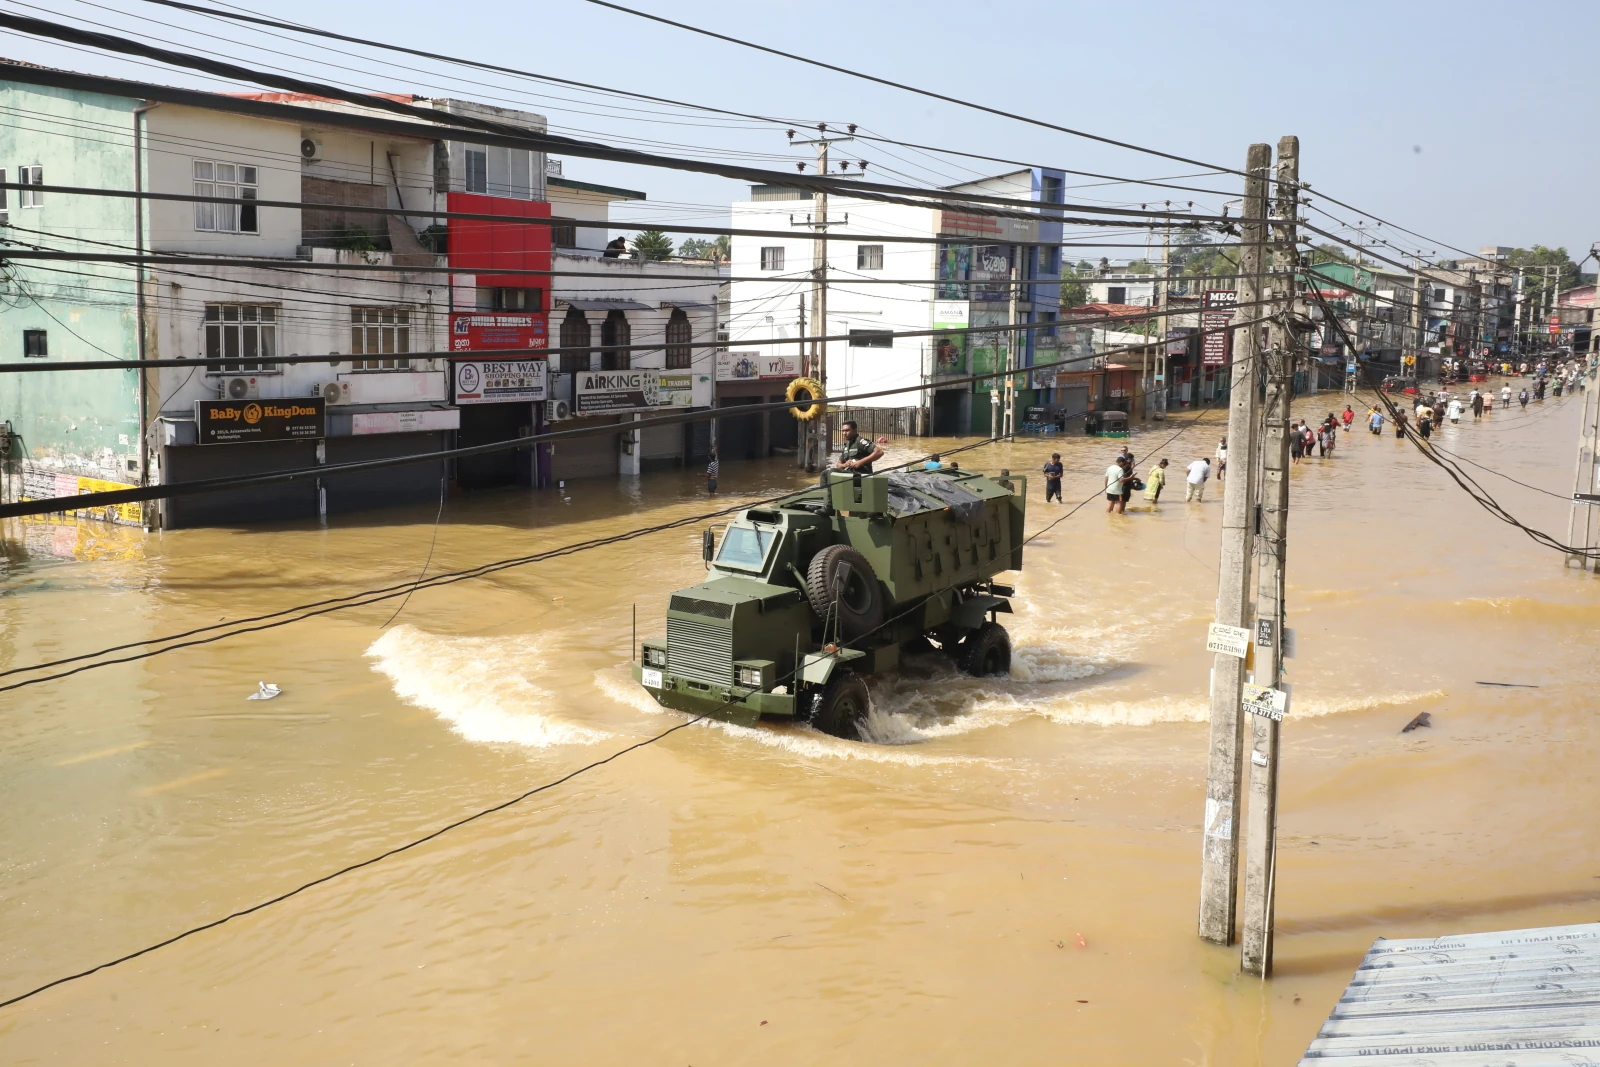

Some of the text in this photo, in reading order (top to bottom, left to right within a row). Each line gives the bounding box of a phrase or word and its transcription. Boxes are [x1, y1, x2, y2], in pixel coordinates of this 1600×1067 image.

[470, 316, 495, 327] NUHA
[496, 316, 532, 327] TRAVELS
[482, 362, 544, 373] BEST WAY
[485, 372, 521, 380] SHOPPING
[667, 379, 691, 387] TRADERS
[210, 405, 316, 421] BaBy KingDom
[1259, 709, 1271, 718] 377
